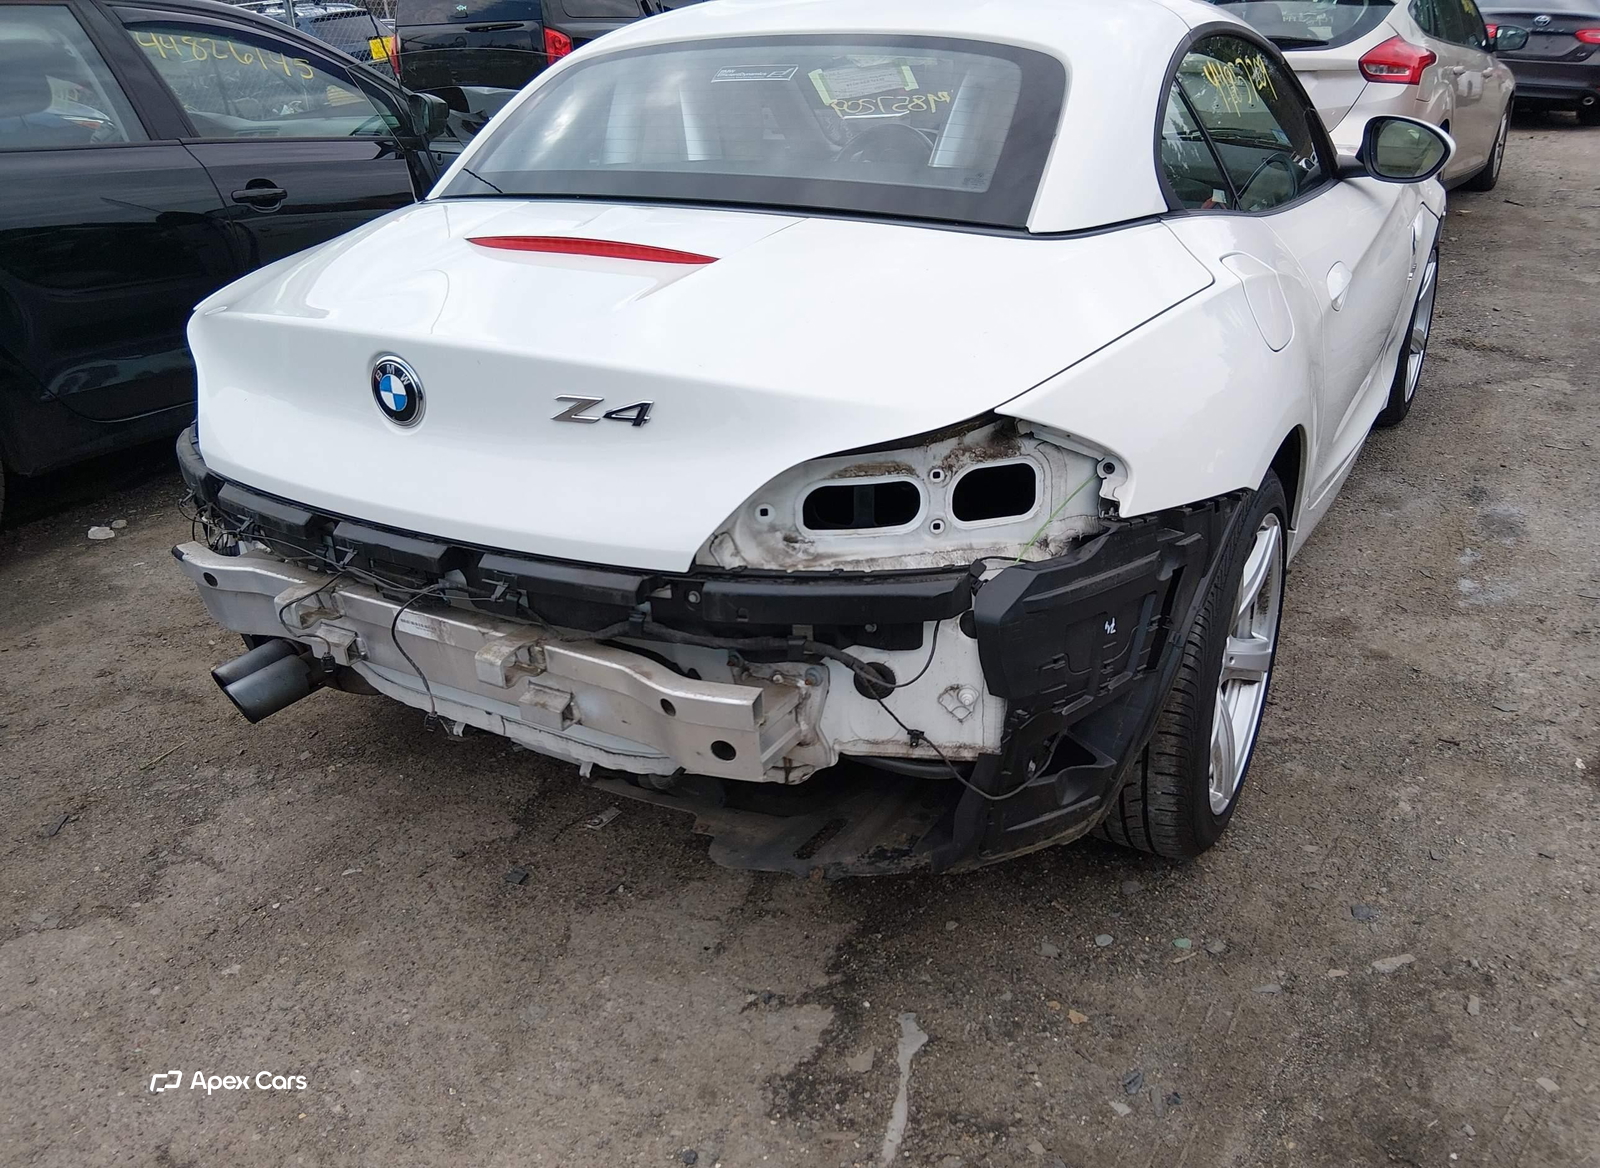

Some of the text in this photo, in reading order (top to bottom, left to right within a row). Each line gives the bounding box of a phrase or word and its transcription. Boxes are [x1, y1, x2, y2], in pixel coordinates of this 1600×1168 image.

[135, 31, 315, 80] 44826145
[375, 364, 411, 386] BMW
[550, 394, 654, 427] Z4
